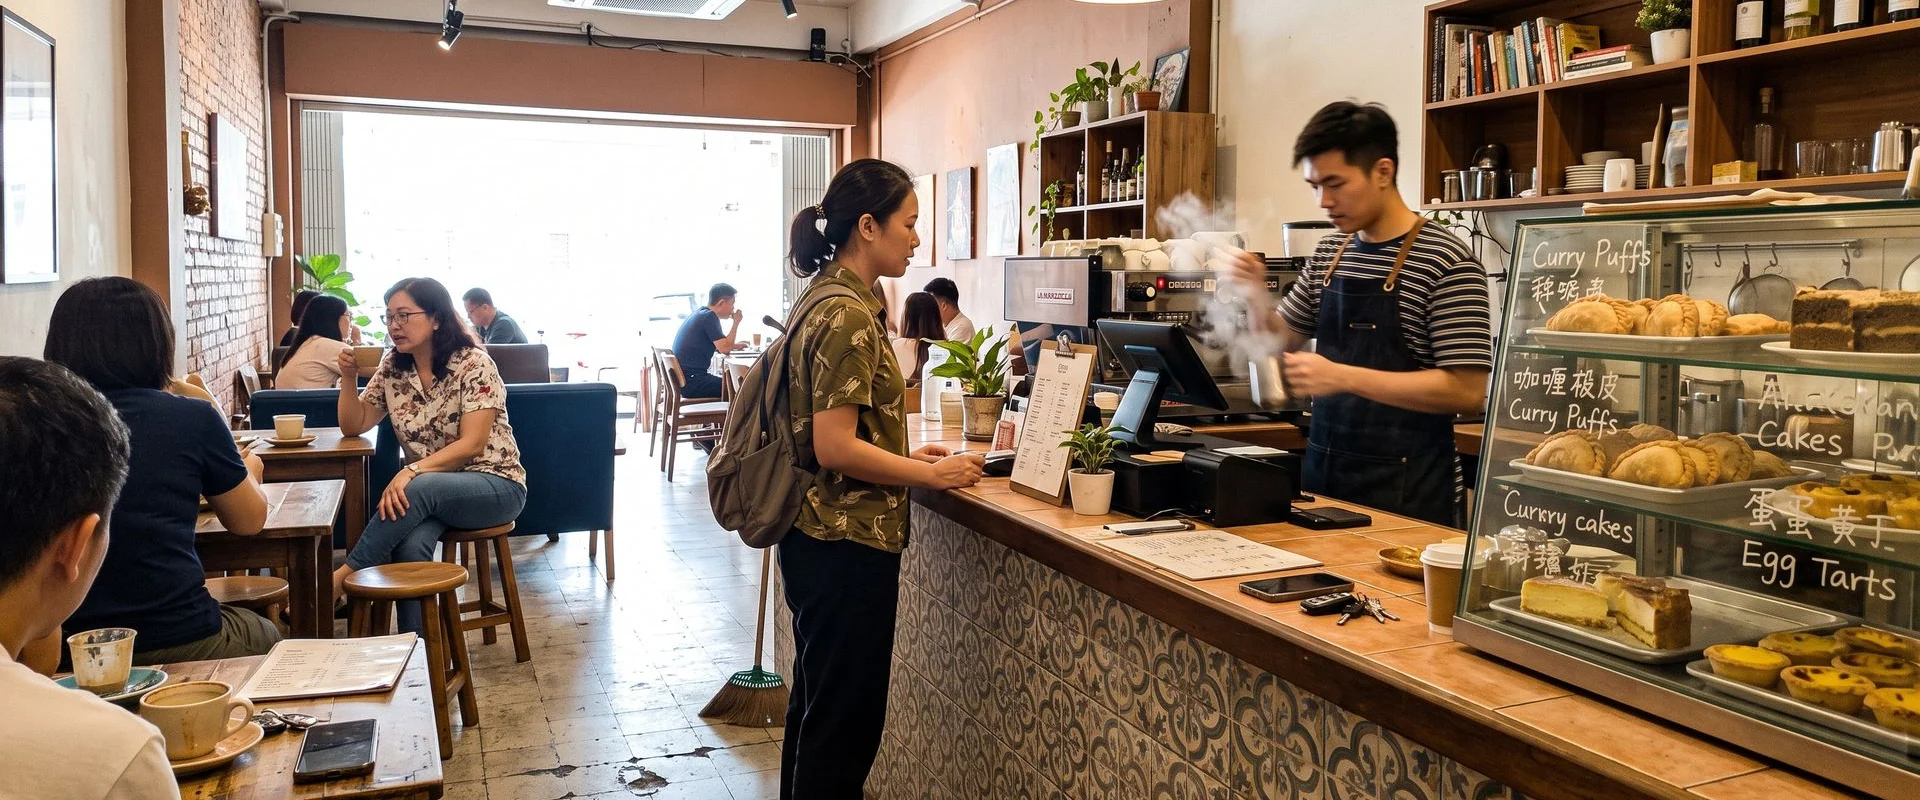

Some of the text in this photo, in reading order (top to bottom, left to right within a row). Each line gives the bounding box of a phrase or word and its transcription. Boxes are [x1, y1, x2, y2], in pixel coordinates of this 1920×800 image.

[1533, 238, 1651, 278] Curry Puffs
[1509, 398, 1618, 440] Curry Puffs
[1758, 420, 1843, 456] Cakes
[1575, 509, 1633, 544] cakes
[1742, 539, 1896, 601] Egg Tarts
